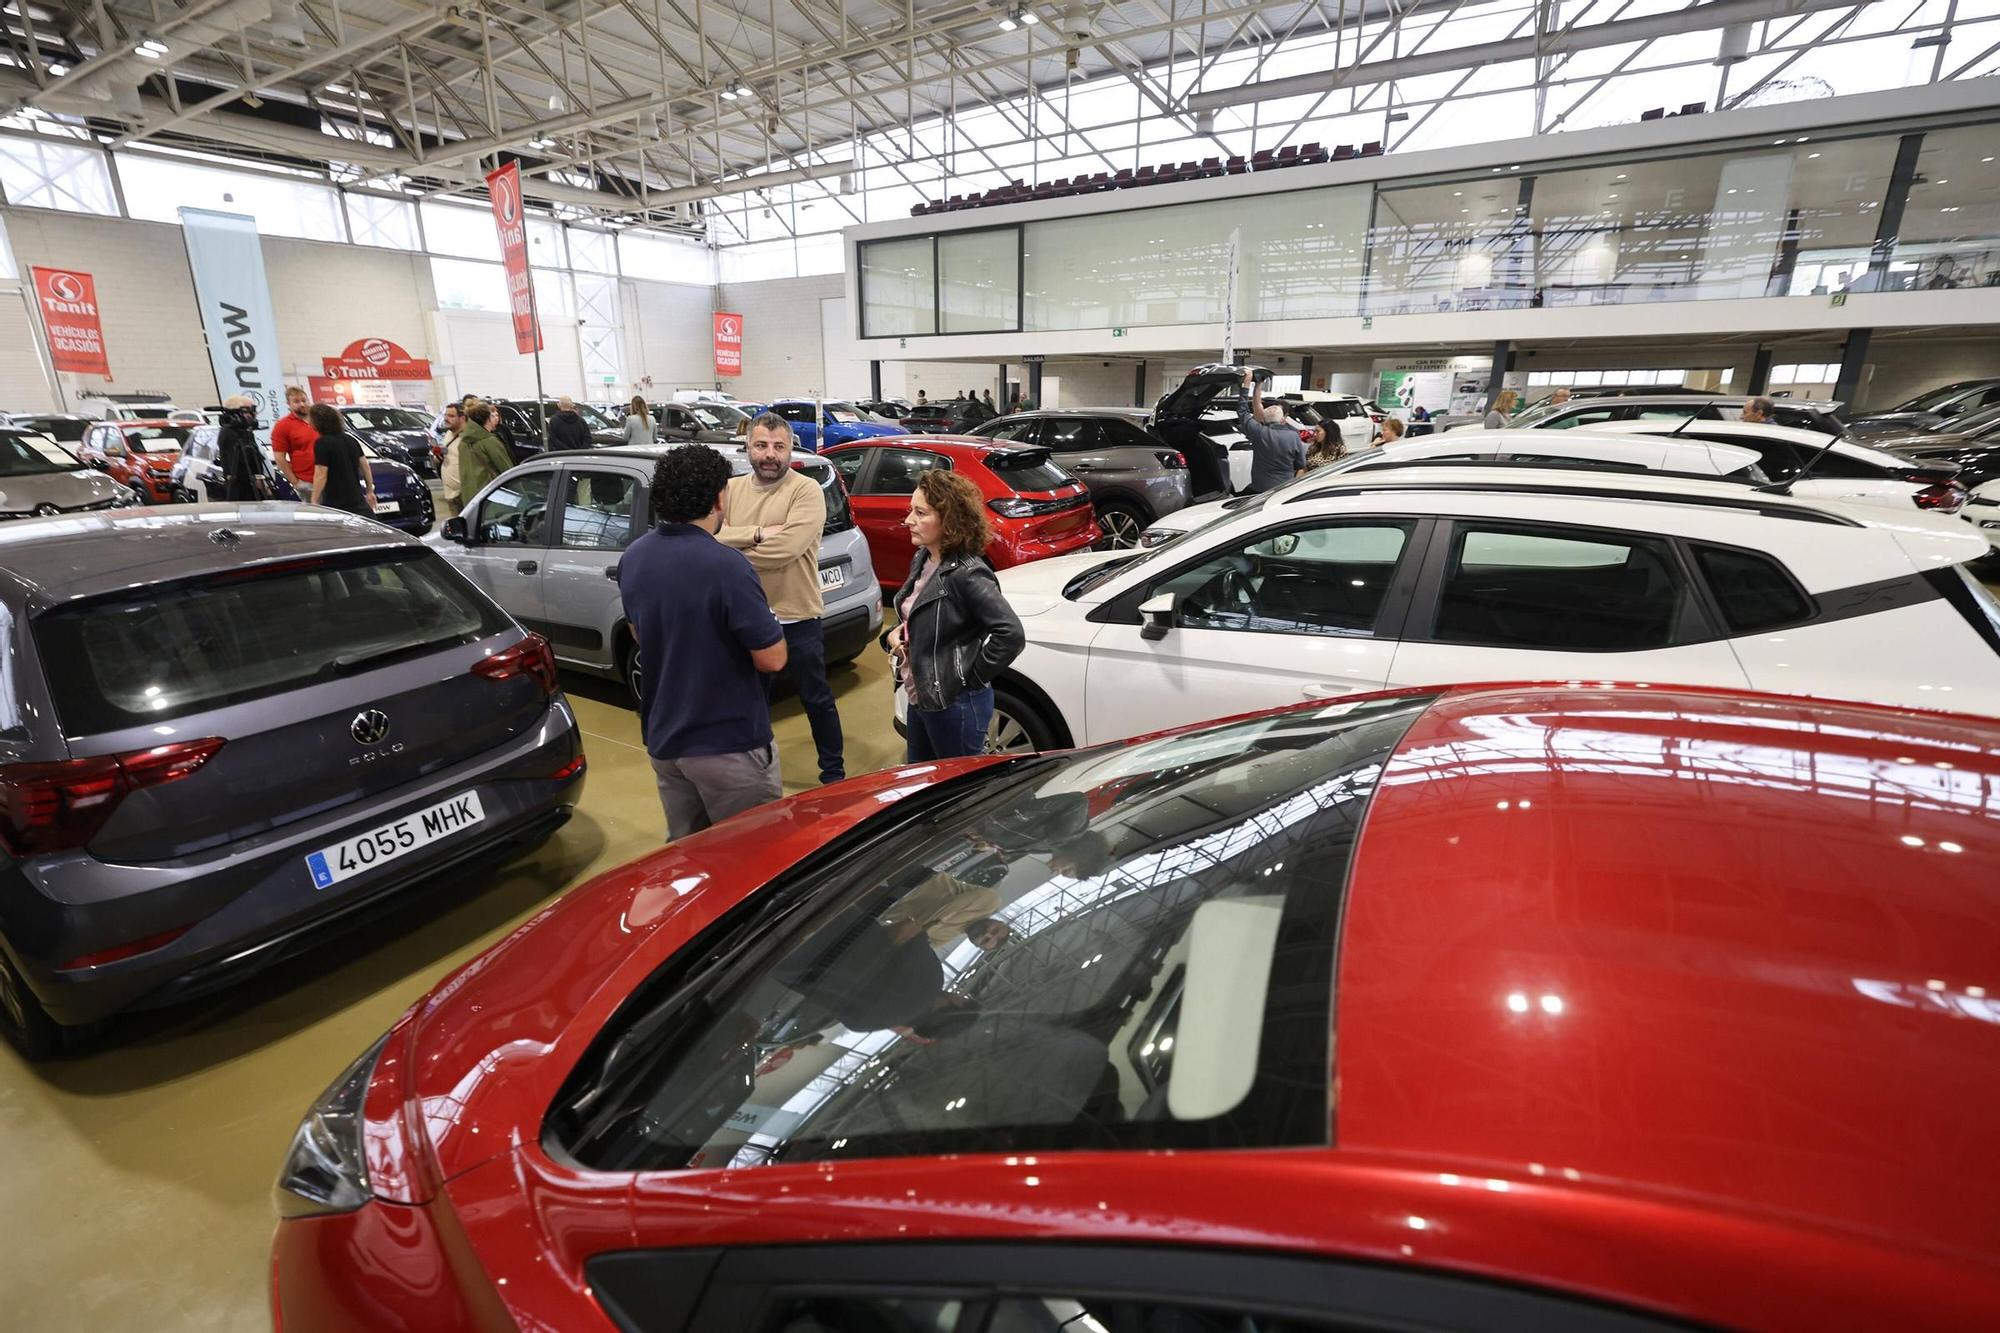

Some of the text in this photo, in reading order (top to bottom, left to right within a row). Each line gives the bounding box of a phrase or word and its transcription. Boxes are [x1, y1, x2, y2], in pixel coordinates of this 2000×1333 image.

[43, 297, 96, 316] Tanit
[716, 332, 741, 344] Tanit
[339, 365, 379, 378] Tanit
[821, 568, 841, 586] MCD
[339, 797, 476, 871] 4055 MHK
